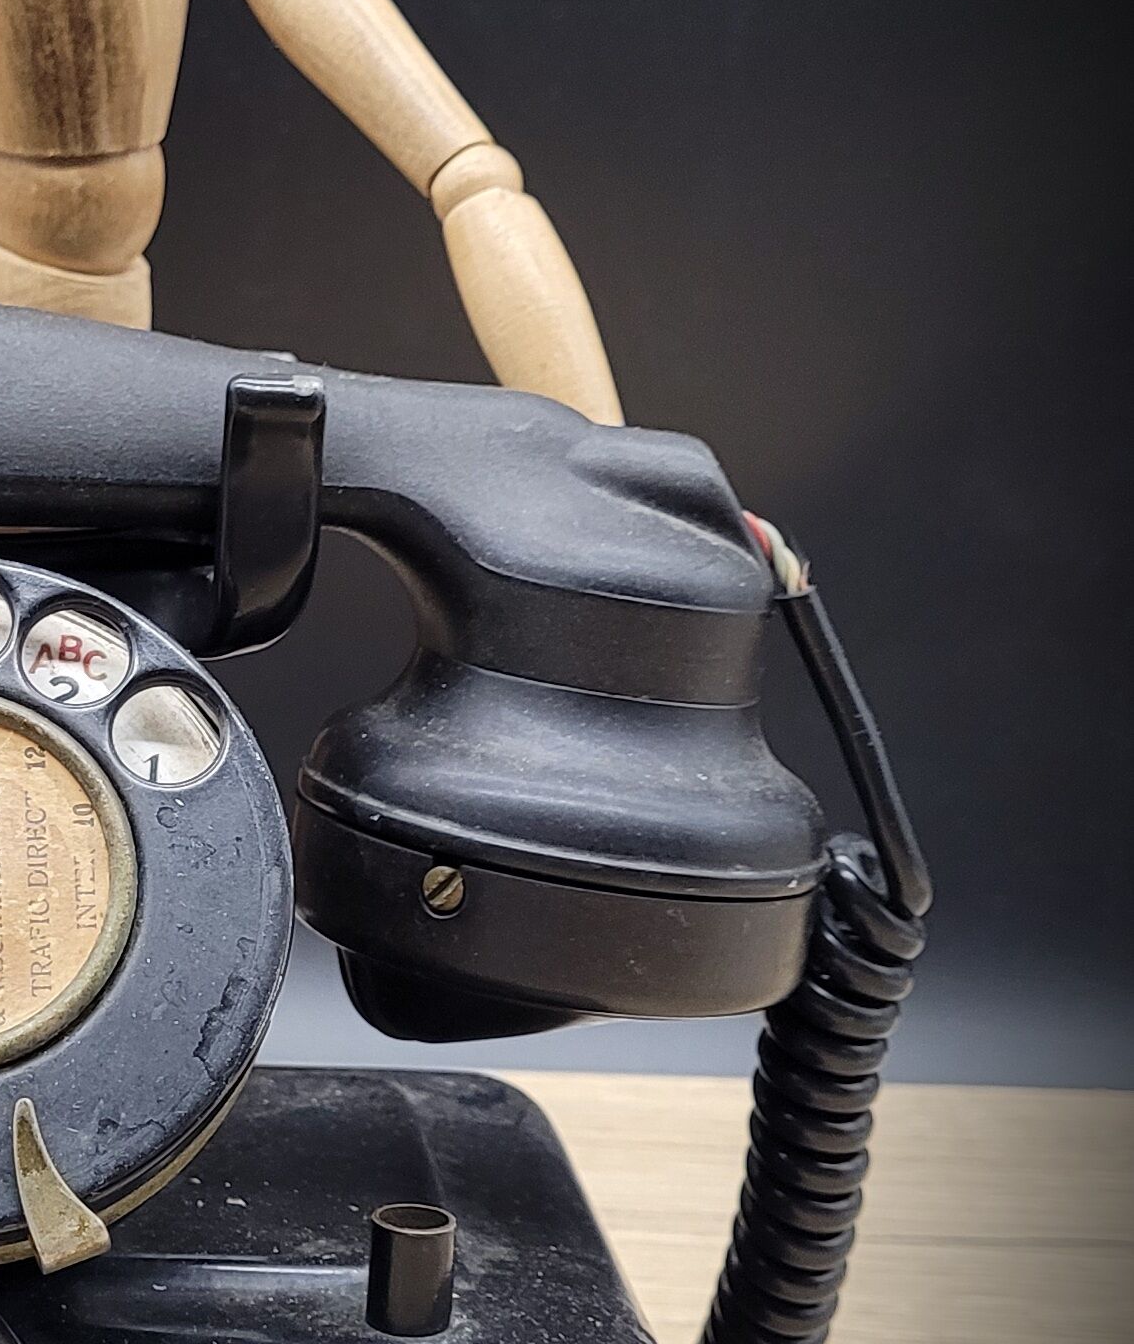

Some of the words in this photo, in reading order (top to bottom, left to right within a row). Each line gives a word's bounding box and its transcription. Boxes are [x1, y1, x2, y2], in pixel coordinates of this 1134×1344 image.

[29, 633, 108, 680] ABC
[49, 675, 80, 702] 2
[24, 745, 46, 770] 12
[143, 753, 160, 783] 1
[72, 803, 96, 828] 10
